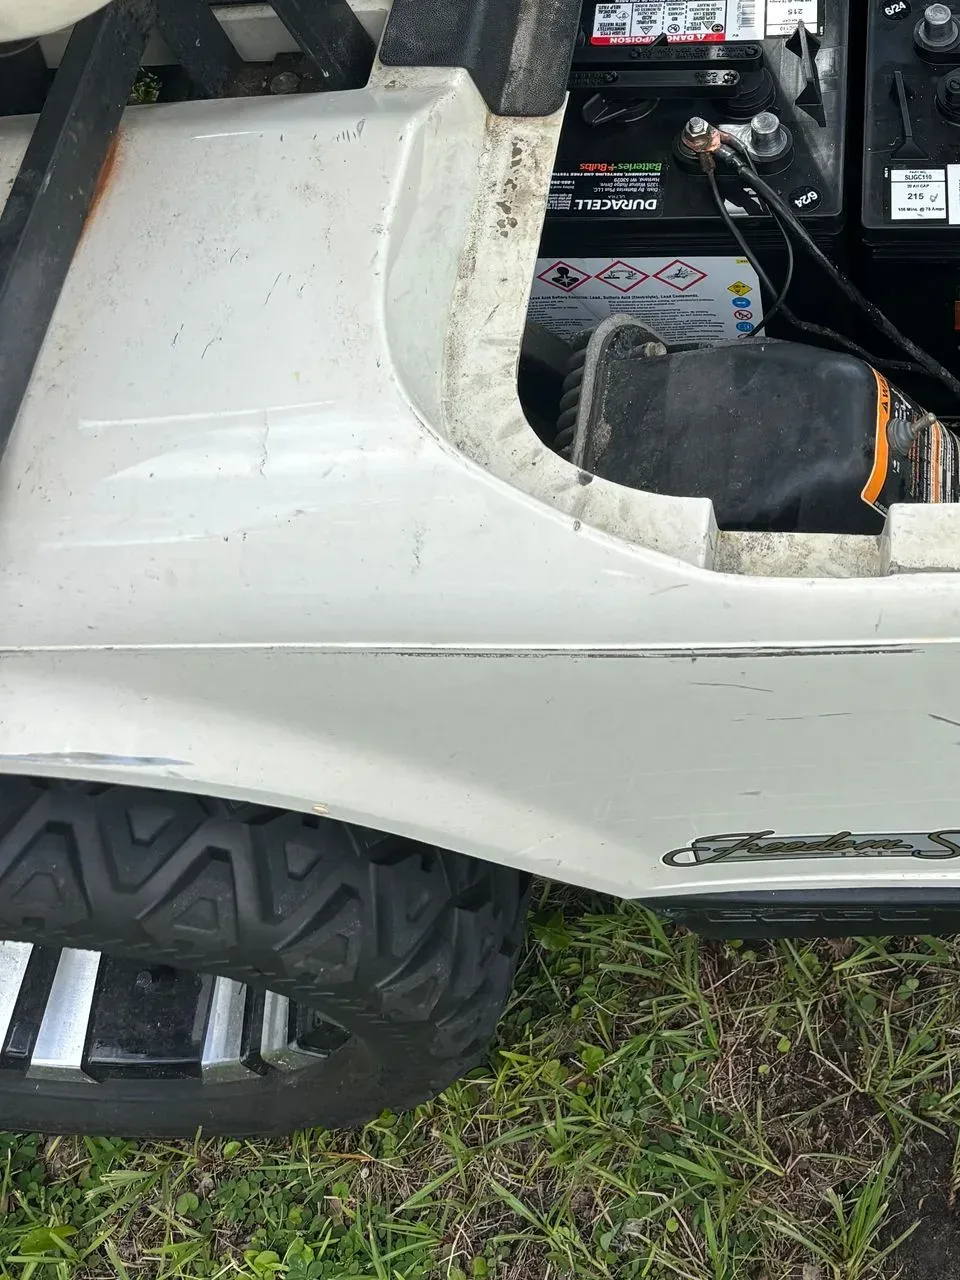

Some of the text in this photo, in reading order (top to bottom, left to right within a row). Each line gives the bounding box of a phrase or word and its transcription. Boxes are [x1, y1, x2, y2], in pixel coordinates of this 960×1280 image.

[884, 1, 906, 16] 6/24
[575, 200, 658, 210] DURACELL
[795, 191, 818, 207] 6/24
[660, 829, 913, 867] Freedom
